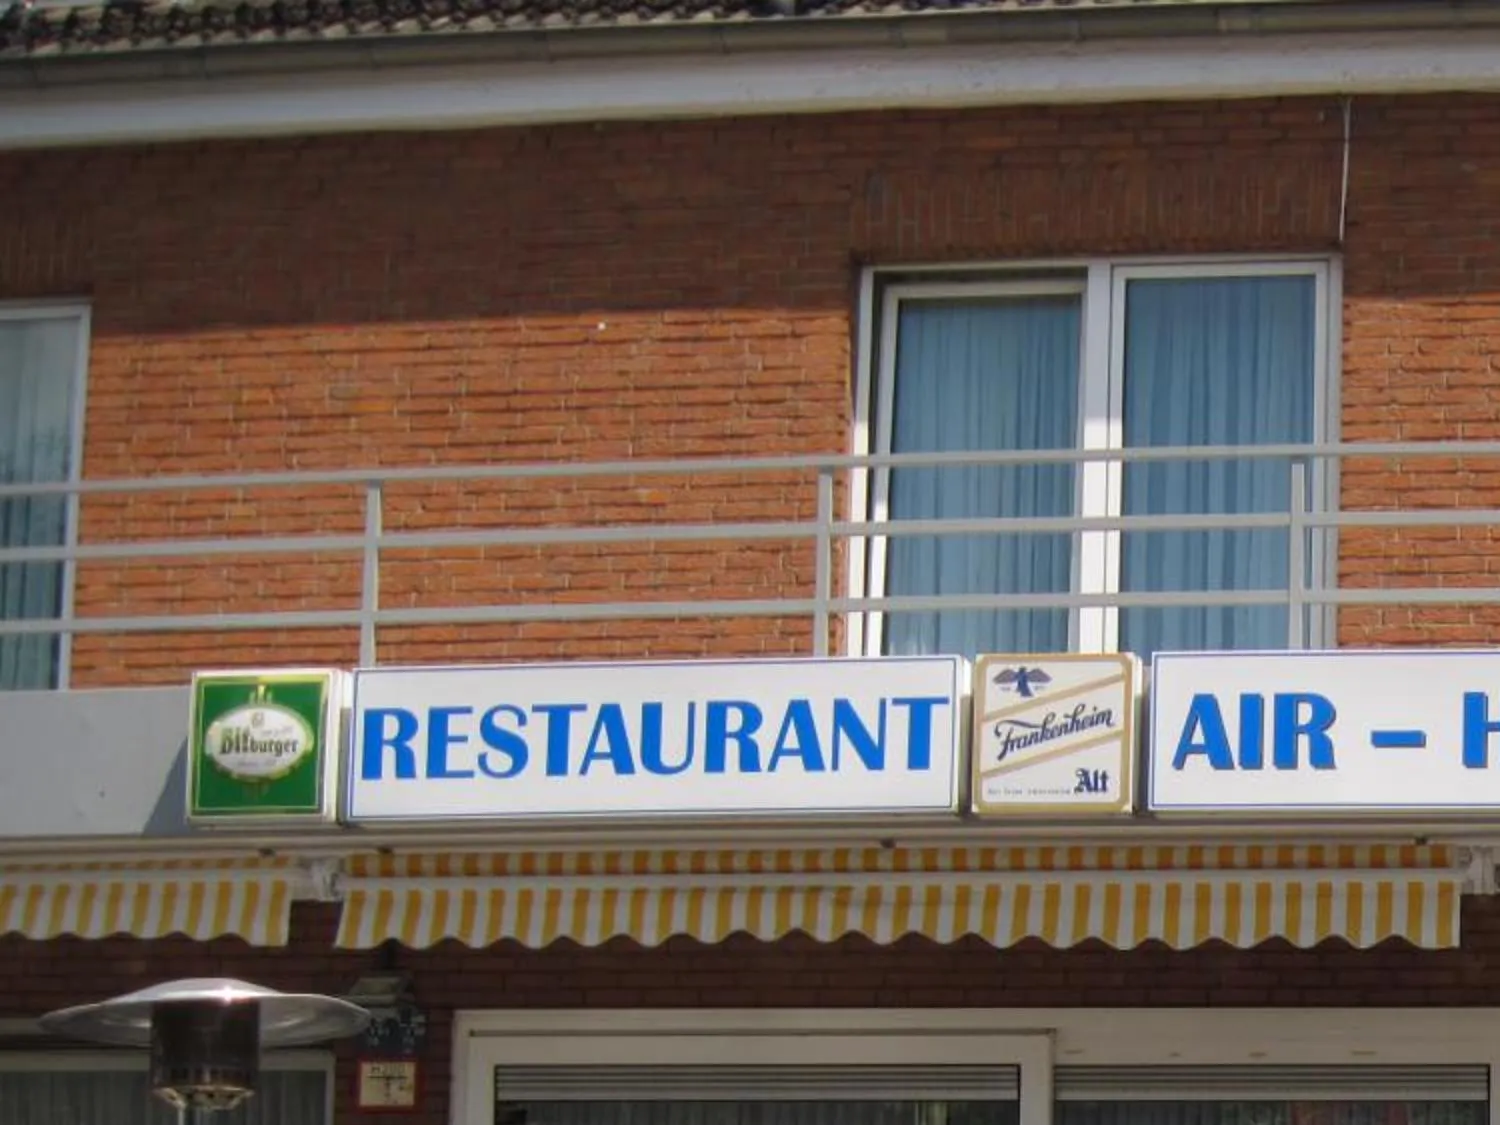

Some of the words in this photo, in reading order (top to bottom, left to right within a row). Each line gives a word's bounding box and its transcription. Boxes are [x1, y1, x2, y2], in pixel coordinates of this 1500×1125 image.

[361, 697, 949, 780] RESTAURANT
[994, 703, 1115, 761] Frankenheim
[1172, 692, 1337, 770] AIR
[1074, 768, 1109, 793] Alt
